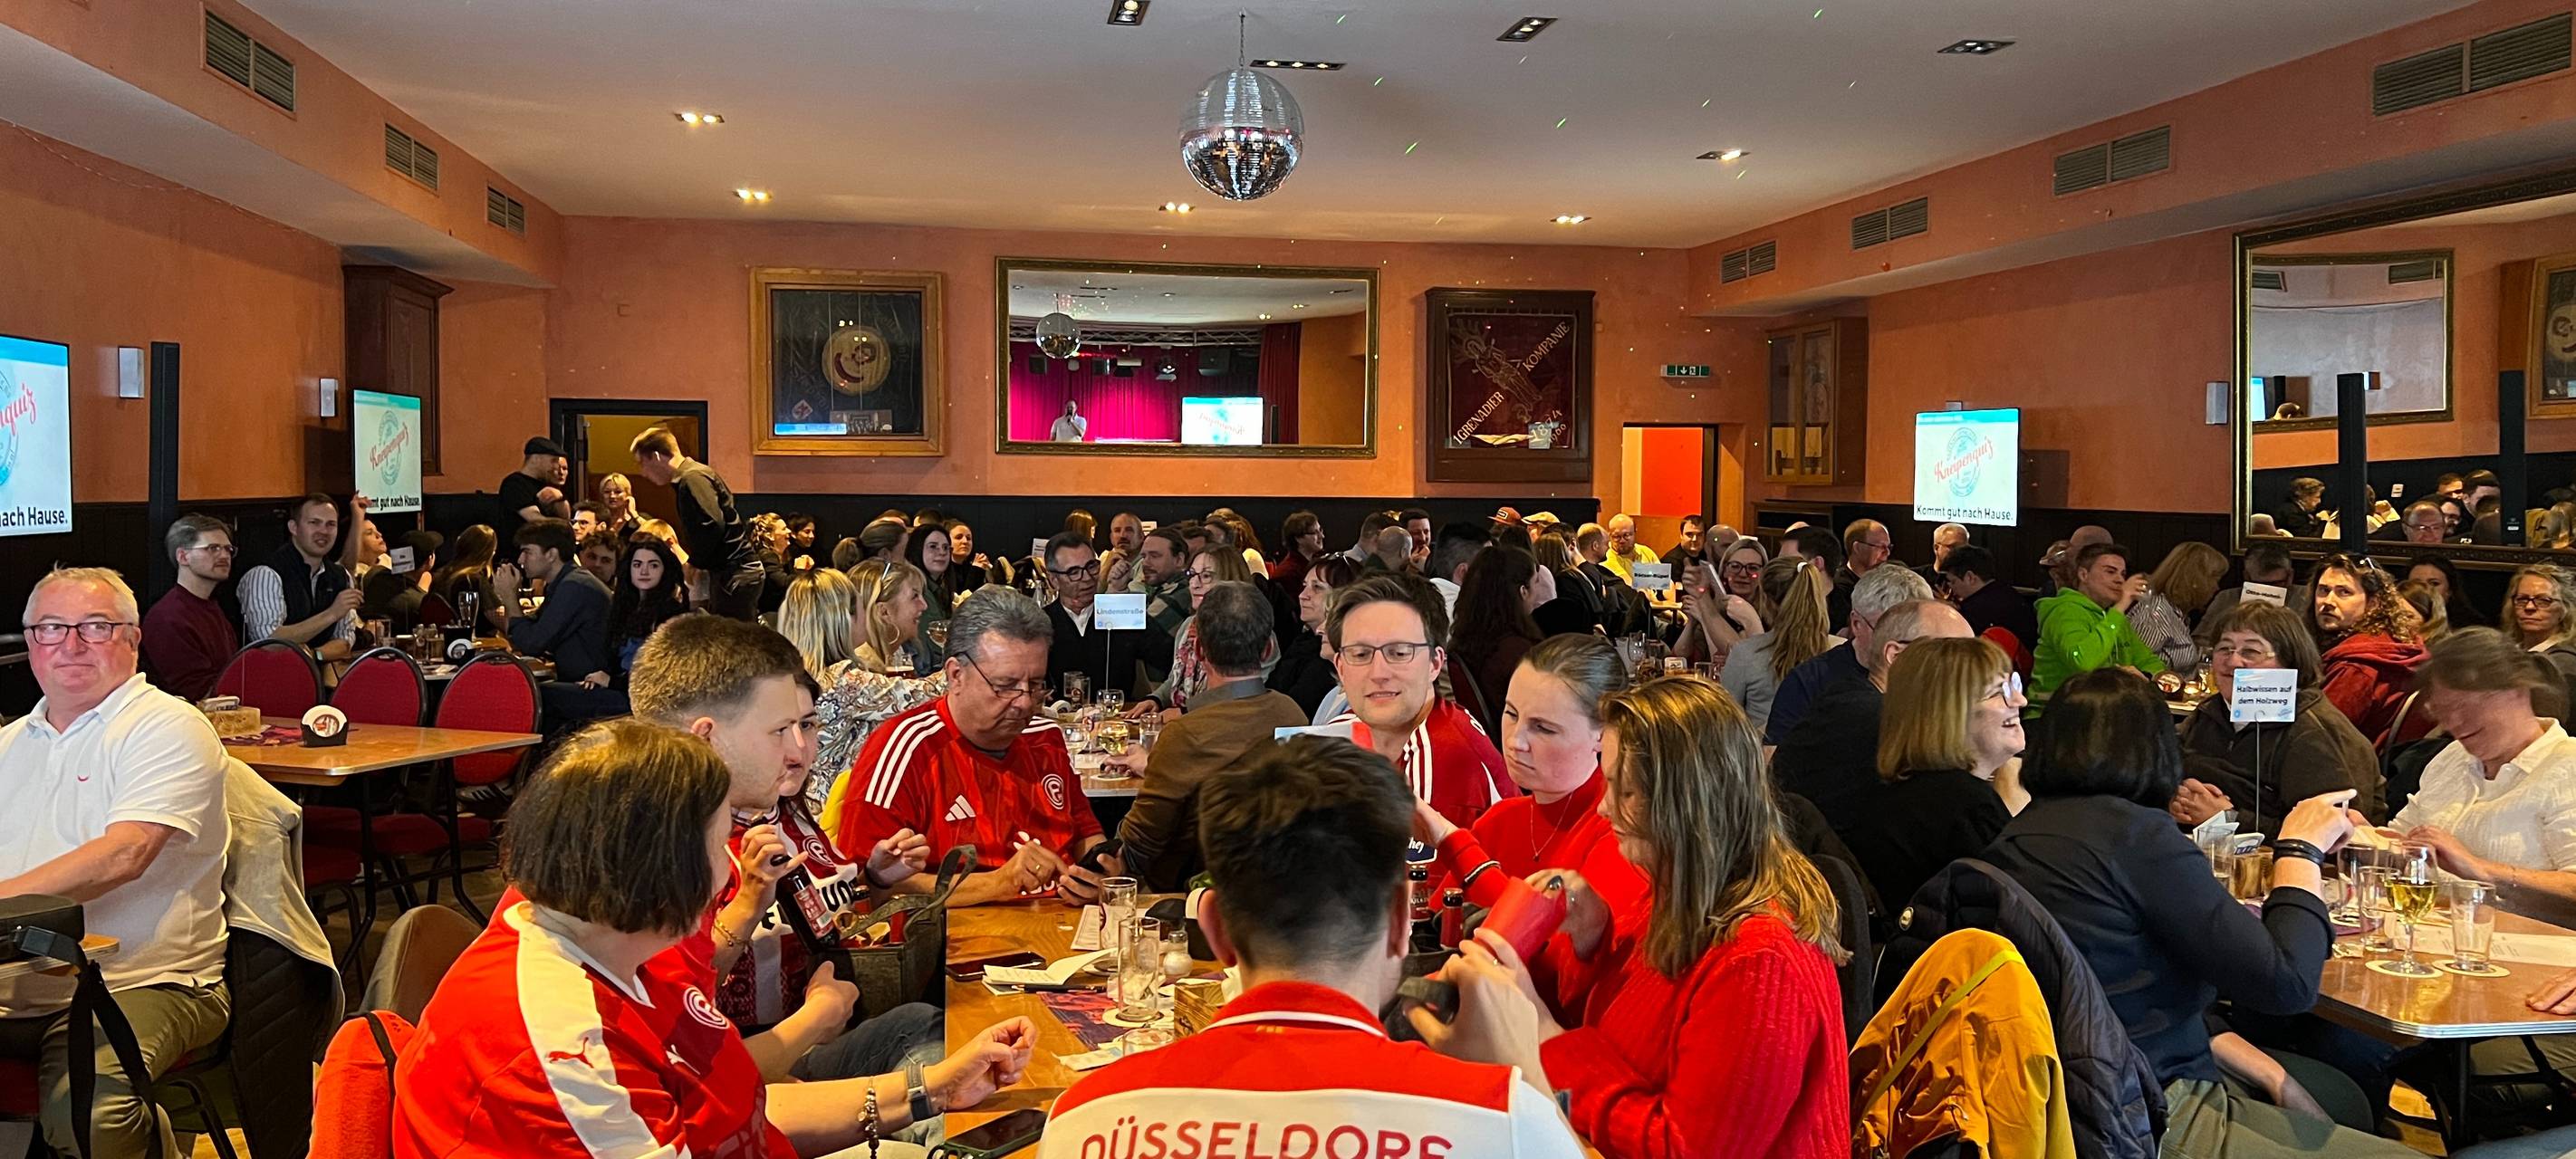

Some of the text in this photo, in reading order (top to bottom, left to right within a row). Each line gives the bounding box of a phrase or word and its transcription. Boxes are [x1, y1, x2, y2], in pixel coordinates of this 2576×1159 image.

[1522, 321, 1571, 372] KOMPANIE
[0, 506, 68, 527] ach Hause.
[1917, 505, 2014, 520] Kommt gut nach Hause.
[2256, 697, 2288, 705] Holzweg
